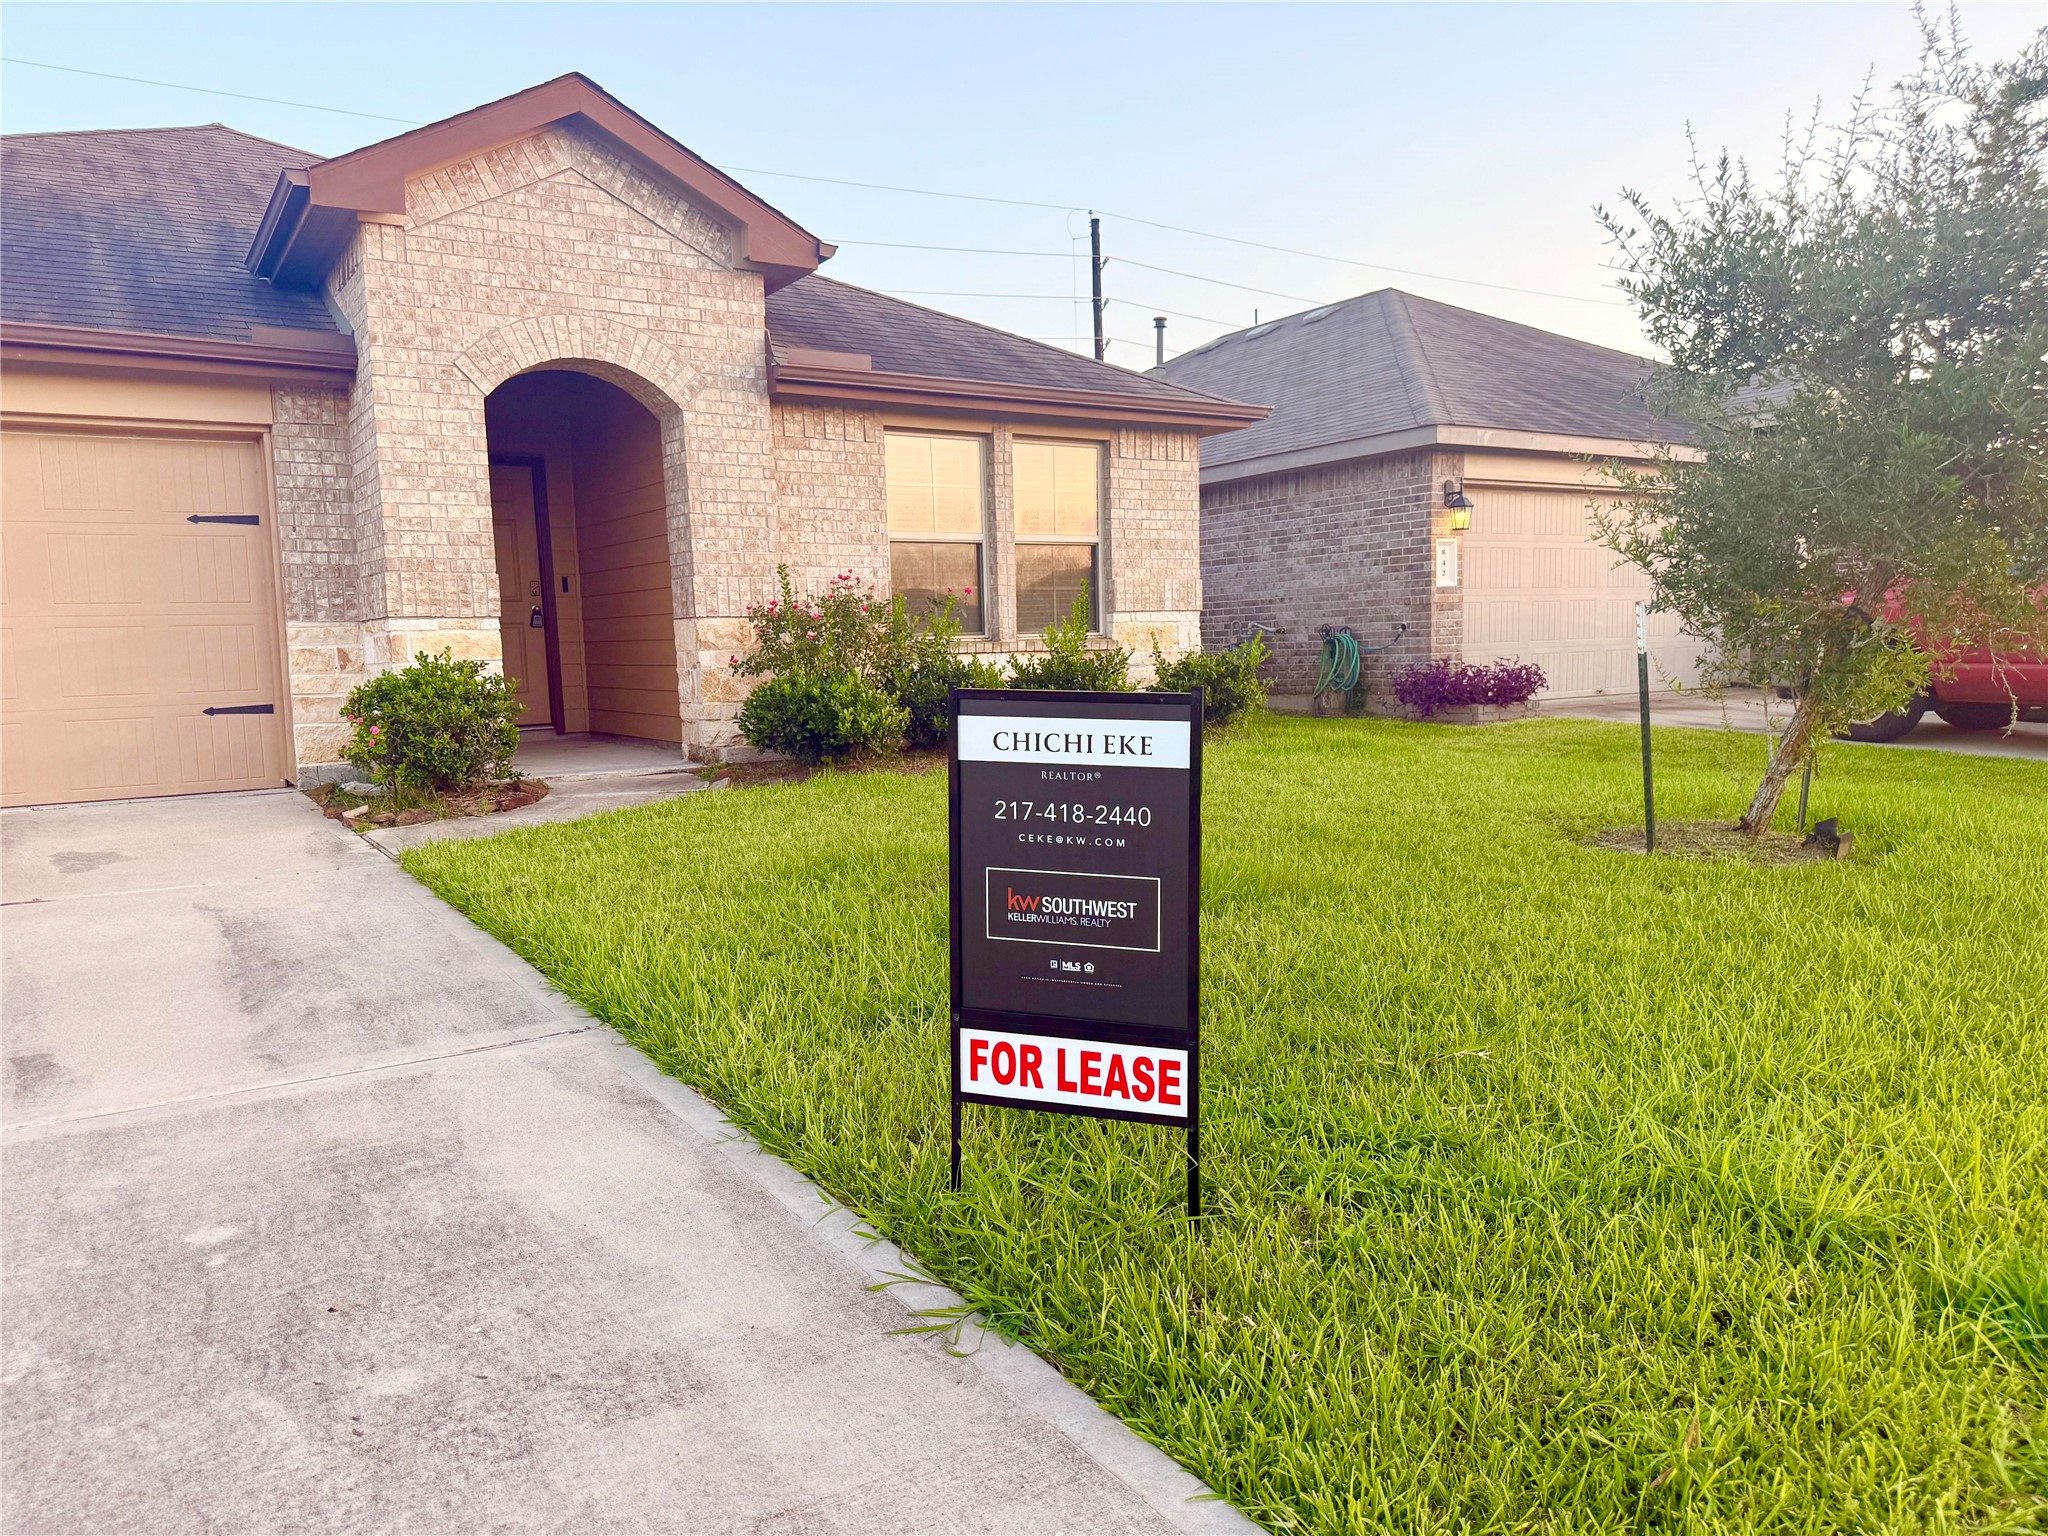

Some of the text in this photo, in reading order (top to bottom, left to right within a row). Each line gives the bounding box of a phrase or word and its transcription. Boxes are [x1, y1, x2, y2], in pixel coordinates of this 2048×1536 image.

[993, 731, 1153, 756] CHICHI EKE
[994, 800, 1152, 827] 217-418-2440
[1018, 833, 1126, 847] CEKE@KW.COM
[1007, 887, 1138, 919] kw SOUTHWEST
[1080, 917, 1111, 928] REALTY
[1062, 961, 1081, 970] MLS
[970, 1038, 1181, 1106] FOR LEASE
